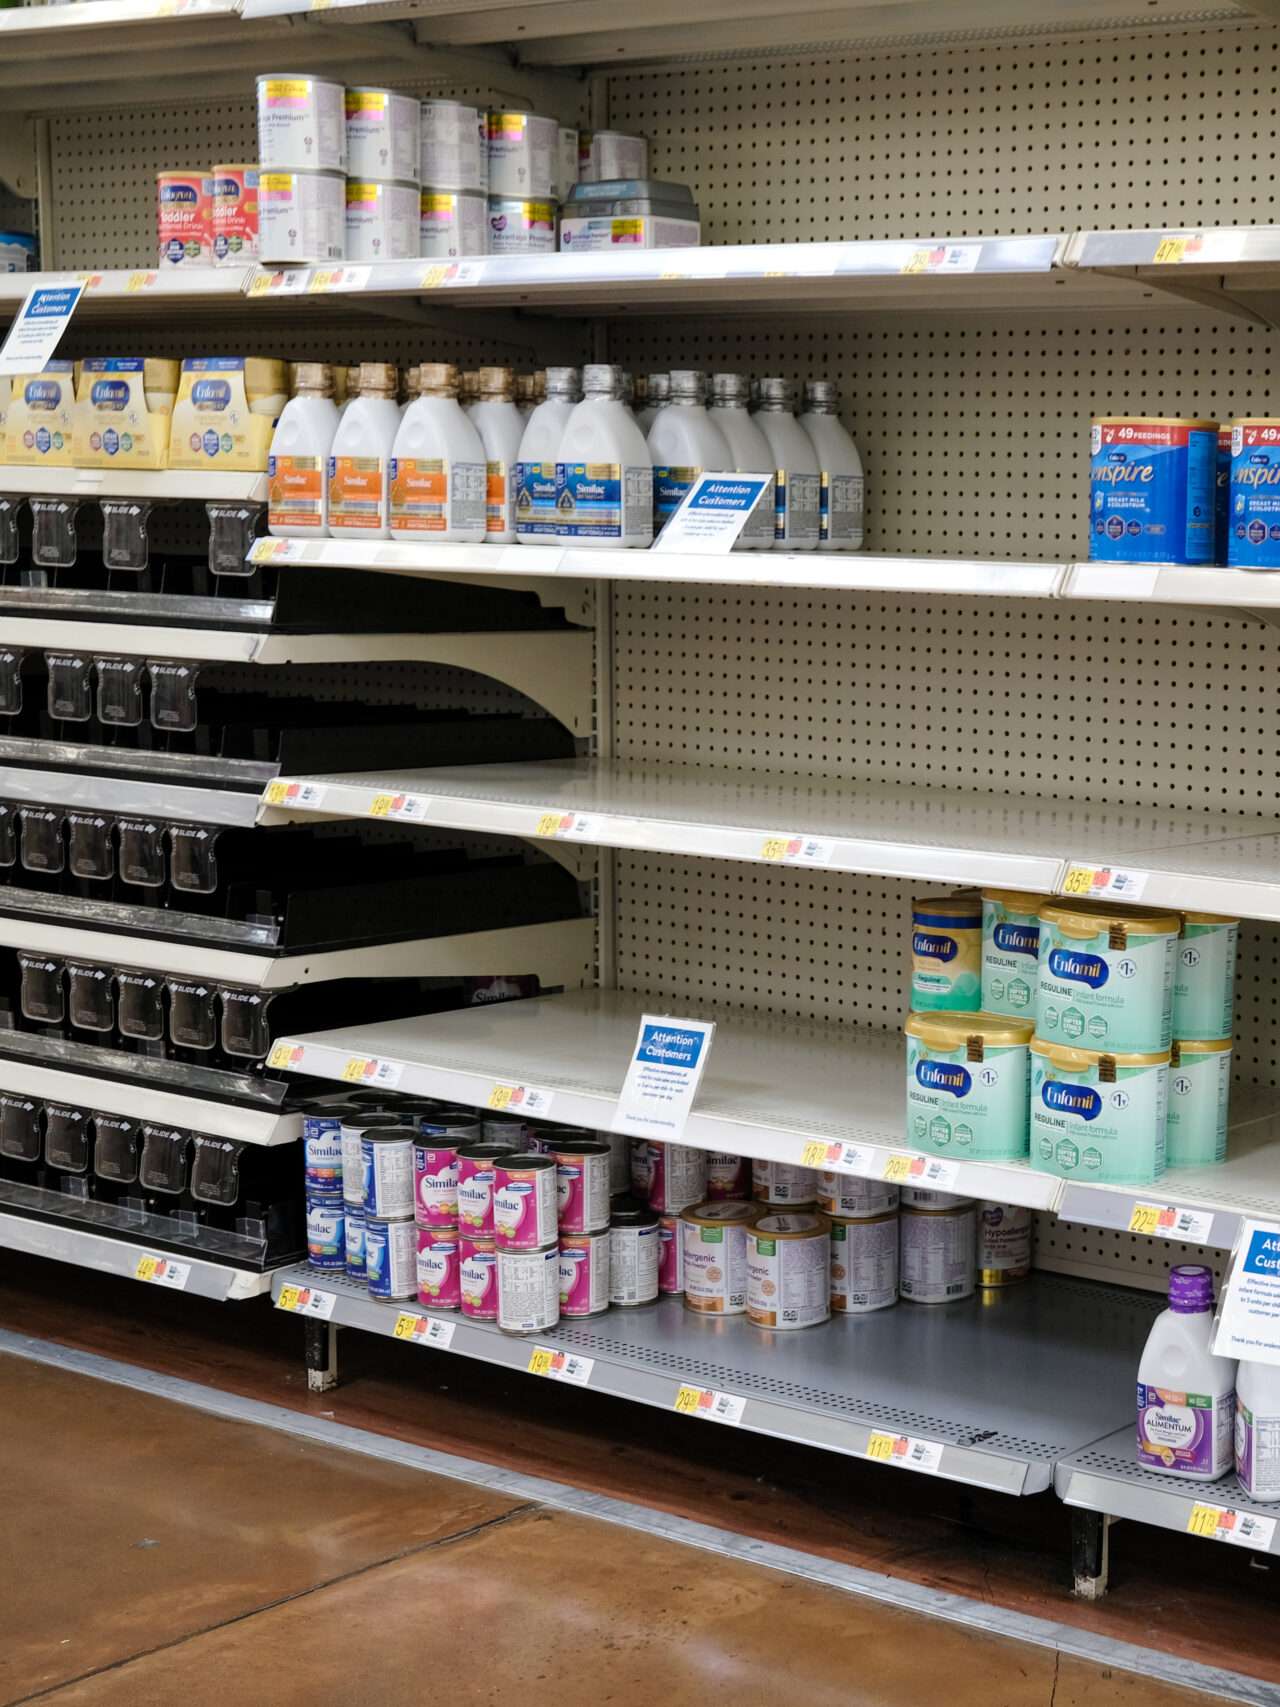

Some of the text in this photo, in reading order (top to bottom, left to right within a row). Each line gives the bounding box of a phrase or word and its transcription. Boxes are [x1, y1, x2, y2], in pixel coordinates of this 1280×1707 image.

[1118, 427, 1133, 440] 49
[1261, 428, 1277, 440] 49
[533, 481, 556, 493] Simila
[576, 482, 605, 494] Similac
[707, 485, 752, 495] Attention
[698, 496, 746, 507] Customers
[914, 937, 952, 955] Enfamil
[1054, 953, 1102, 979] Enfamil
[1040, 980, 1073, 997] REGULINE
[651, 1031, 694, 1046] Attention
[646, 1045, 692, 1062] Customers
[920, 1069, 965, 1088] Enfamil
[1046, 1087, 1095, 1111] Enfamil
[425, 1177, 458, 1189] Simila
[1146, 1419, 1192, 1434] ALIMENTUM
